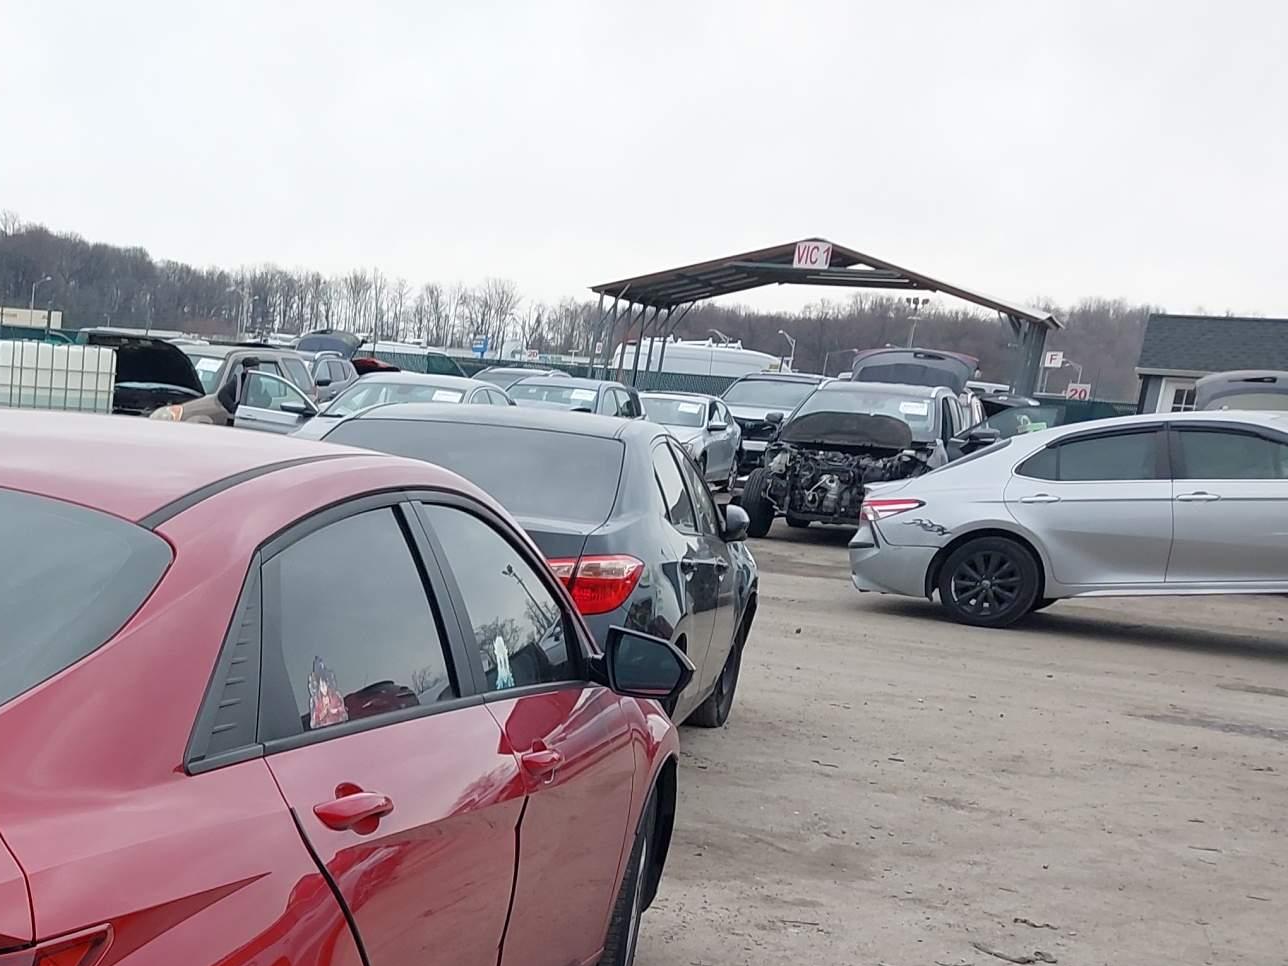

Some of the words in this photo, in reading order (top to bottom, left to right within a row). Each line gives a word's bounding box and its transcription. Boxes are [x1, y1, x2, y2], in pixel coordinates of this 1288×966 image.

[797, 245, 819, 265] VIC
[823, 246, 831, 266] 1
[1049, 353, 1058, 365] F
[1069, 388, 1088, 400] 20
